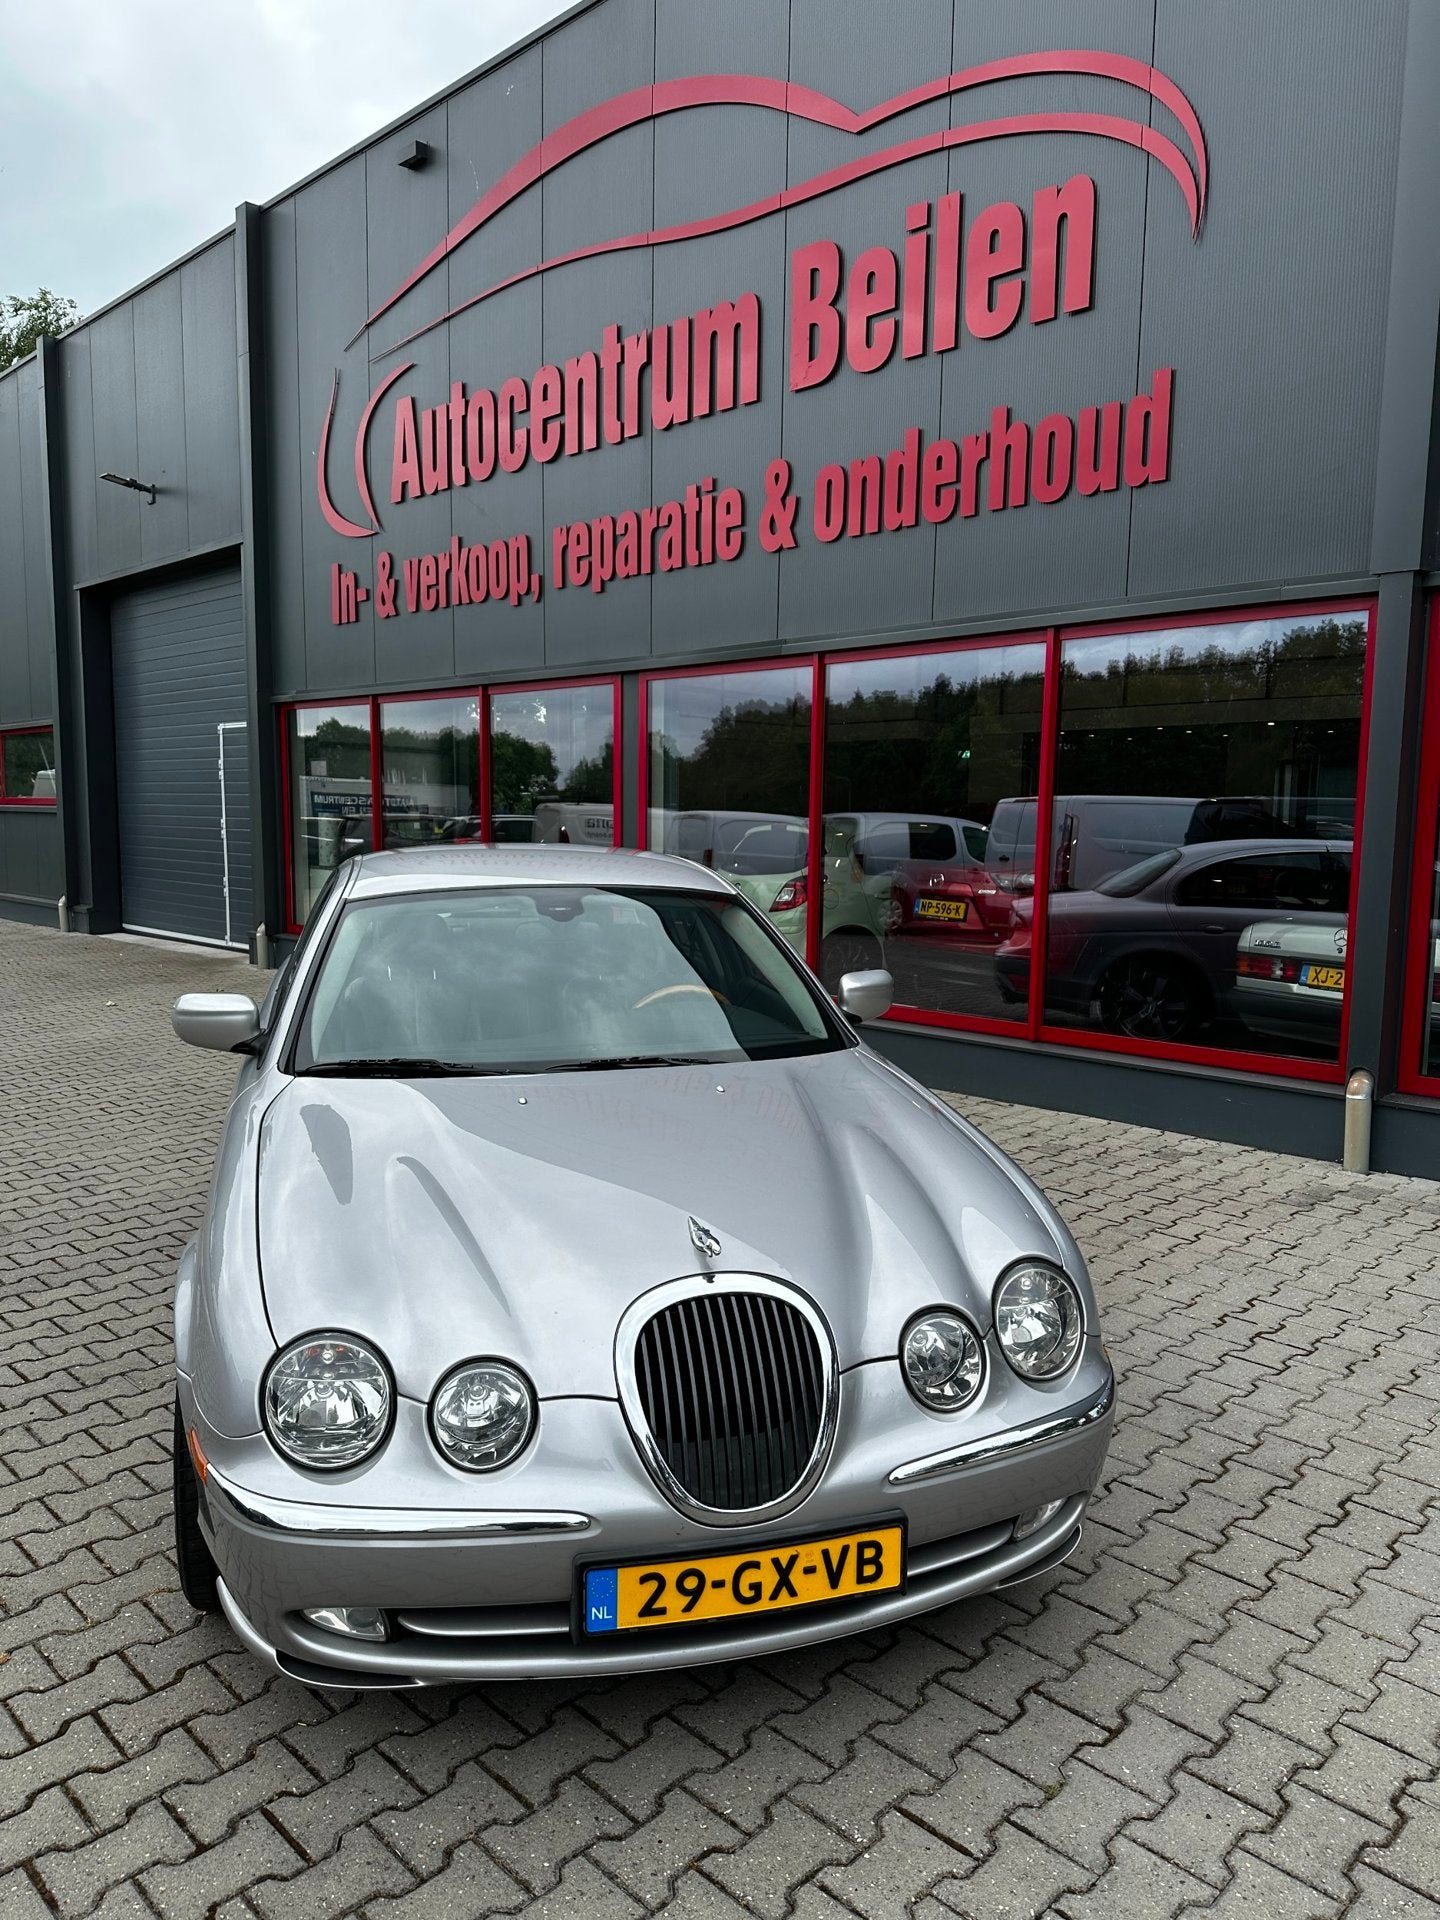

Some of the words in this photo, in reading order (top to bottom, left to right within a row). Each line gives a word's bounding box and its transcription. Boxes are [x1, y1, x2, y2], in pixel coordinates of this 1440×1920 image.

[391, 292, 759, 503] Autocentrum
[790, 174, 1096, 392] Beilen
[332, 562, 369, 625] In-
[376, 552, 397, 619] &
[403, 535, 541, 613] verkoop,
[552, 476, 744, 593] reparatie
[759, 458, 798, 553] &
[813, 368, 1173, 542] onderhoud
[920, 901, 961, 917] NP-596-K
[1311, 967, 1344, 986] XJ-2
[591, 1606, 612, 1621] NL
[637, 1540, 884, 1618] 29-GX-VB
